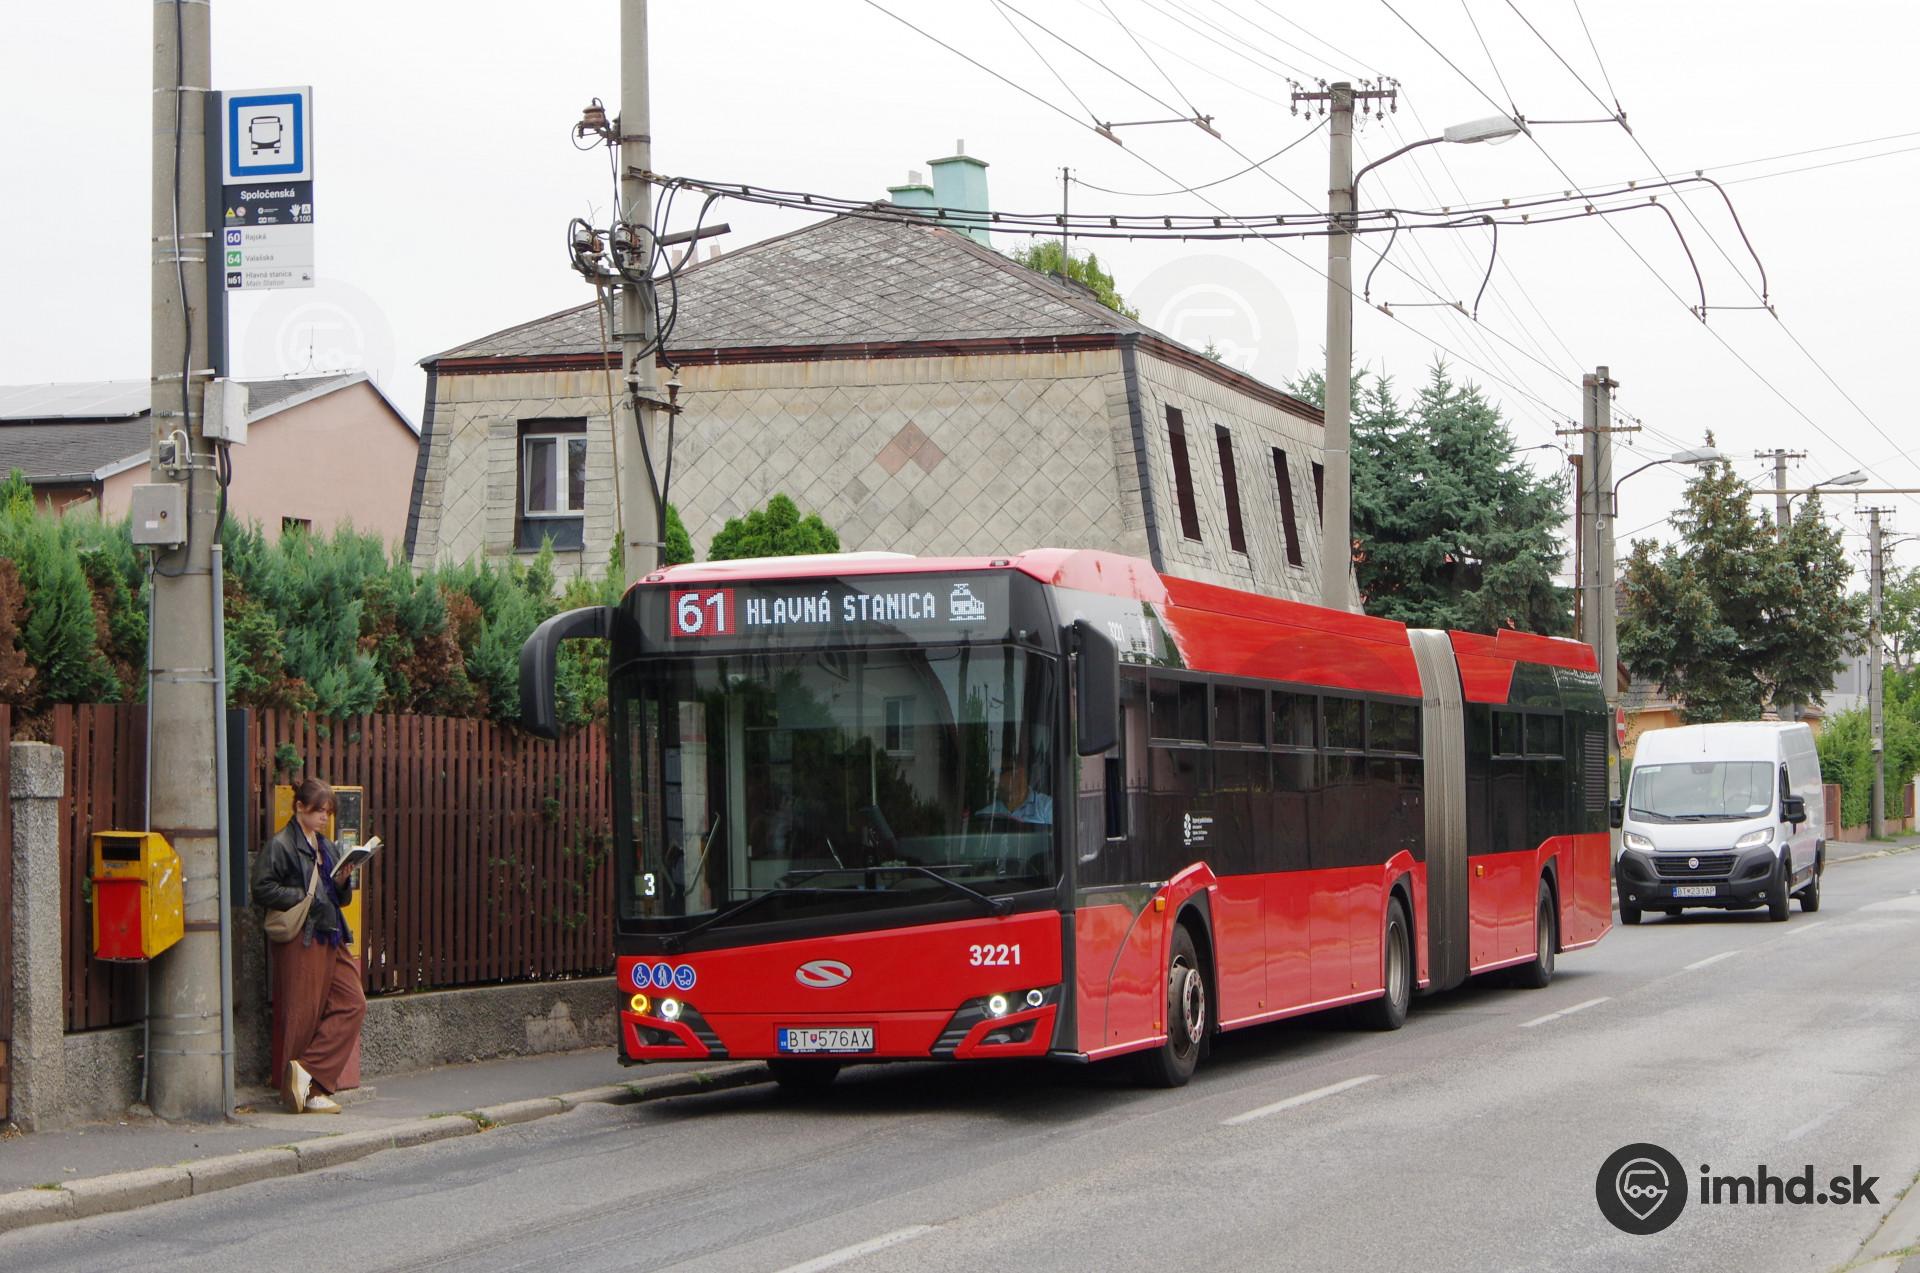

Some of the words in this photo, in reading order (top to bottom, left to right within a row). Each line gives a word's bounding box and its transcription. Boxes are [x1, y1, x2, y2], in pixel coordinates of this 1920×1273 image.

[240, 188, 295, 201] Spoločenská
[227, 232, 241, 243] 60
[227, 253, 241, 264] 64
[245, 271, 268, 279] Hlavná
[677, 592, 726, 633] 61
[747, 590, 831, 625] HLAVNÁ
[843, 592, 936, 622] STANICA
[643, 873, 655, 896] 3
[969, 944, 1020, 966] 3221
[789, 1030, 808, 1047] BT
[818, 1030, 870, 1047] 576AX
